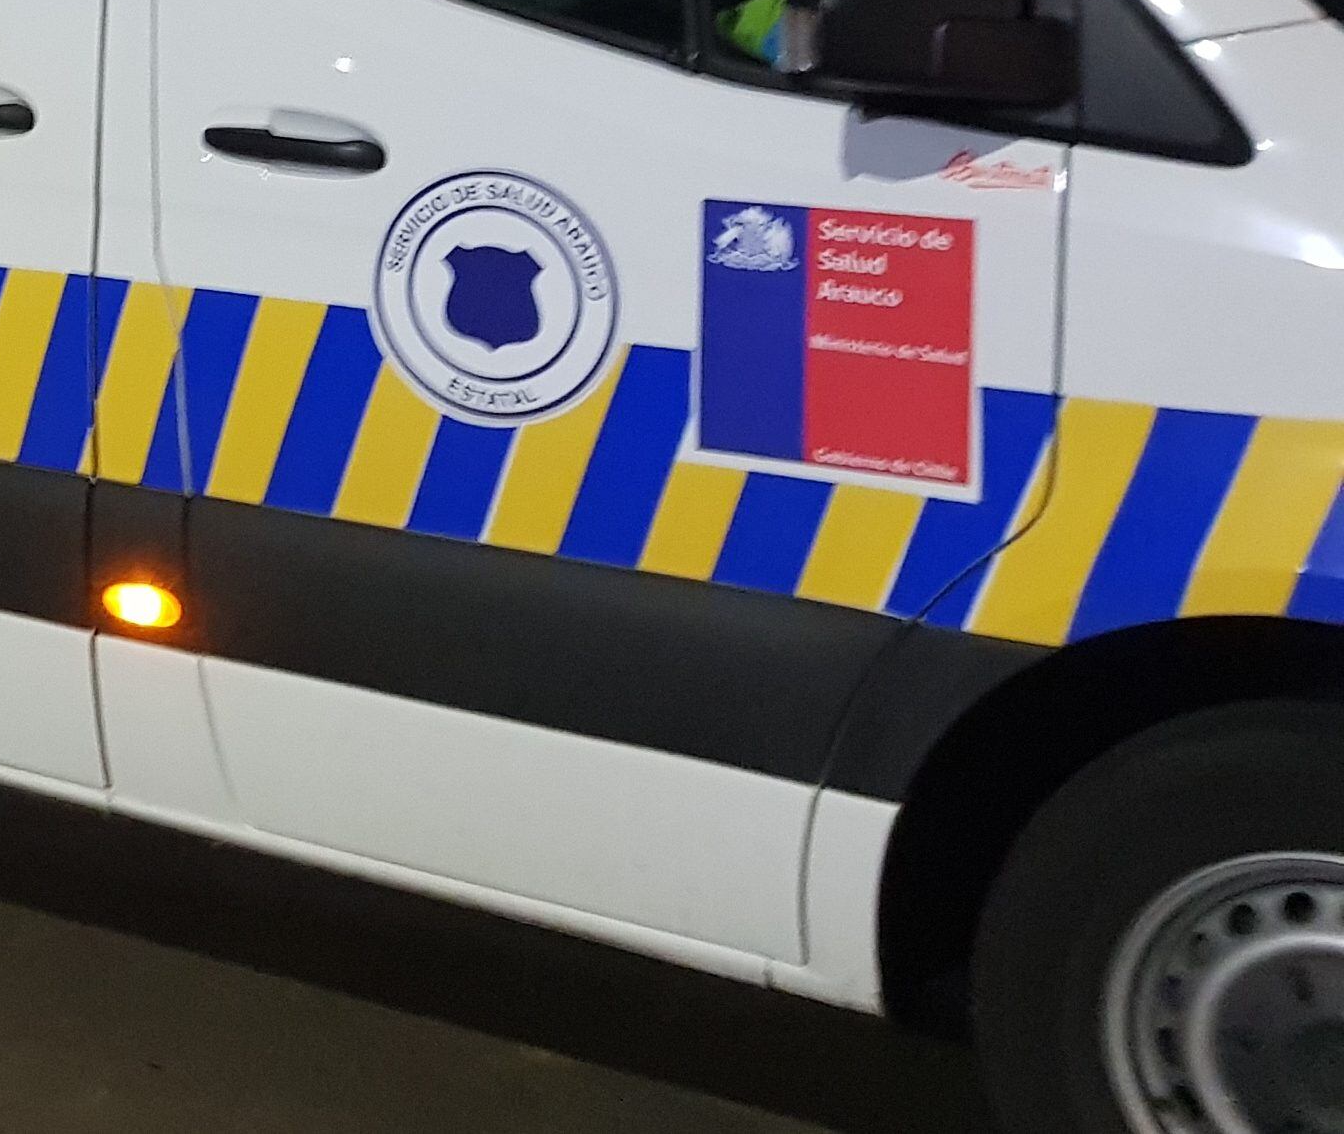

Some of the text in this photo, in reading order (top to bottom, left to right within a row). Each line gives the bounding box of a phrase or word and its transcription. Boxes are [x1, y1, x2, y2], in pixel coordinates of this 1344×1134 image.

[387, 180, 608, 302] SERVICIO DE SALUD ARAUCO
[817, 218, 955, 251] Servicio de
[817, 248, 889, 276] Salud
[815, 278, 904, 308] Arauco
[446, 376, 540, 407] ESTATAL
